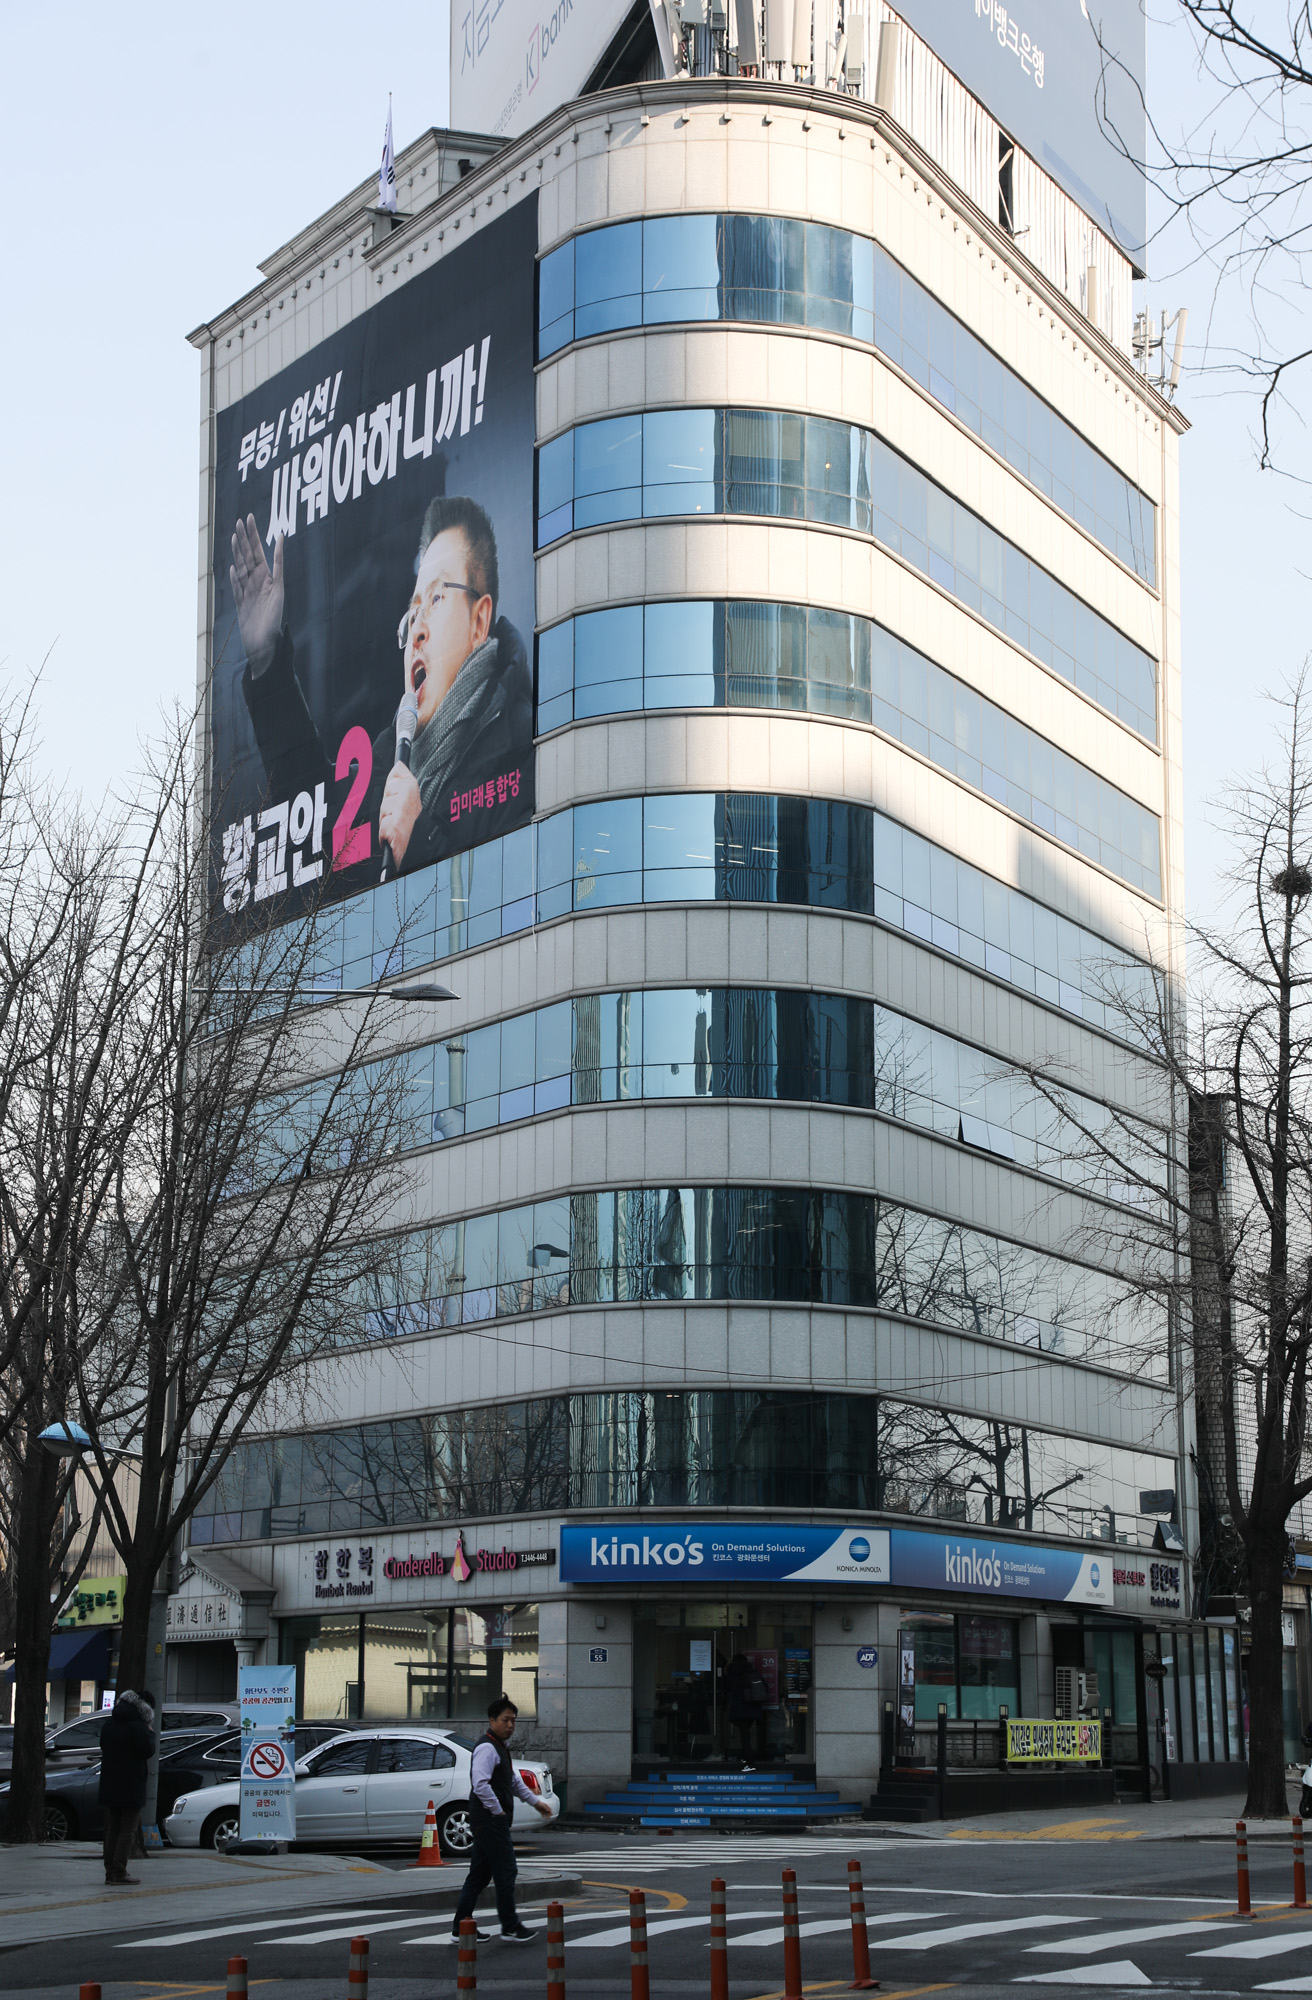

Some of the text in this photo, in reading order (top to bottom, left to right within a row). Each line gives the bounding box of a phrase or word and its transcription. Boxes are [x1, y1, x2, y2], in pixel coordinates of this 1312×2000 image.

[975, 0, 1045, 89] 이뱅크은행
[238, 370, 343, 482] 무능! 위선!
[265, 335, 491, 546] 싸워야하니까!
[461, 768, 521, 813] 미래통합당
[222, 726, 373, 913] 황교안 2
[590, 1534, 704, 1566] kinko's
[711, 1543, 806, 1553] On Demand Solutions
[712, 1554, 770, 1562] 킨코스 광화문센터
[385, 1552, 444, 1579] Cinderella
[476, 1547, 517, 1572] Studio
[945, 1544, 1001, 1588] kinko's
[1003, 1561, 1046, 1575] On Demand Solutions
[315, 1580, 373, 1598] Hanbok Rental
[594, 1654, 603, 1662] 55
[859, 1653, 875, 1662] ADT
[242, 1697, 260, 1705] 공공의
[1056, 1724, 1077, 1757] 우리모두
[256, 1799, 277, 1807] 금연이
[263, 1789, 291, 1797] 공간에서는
